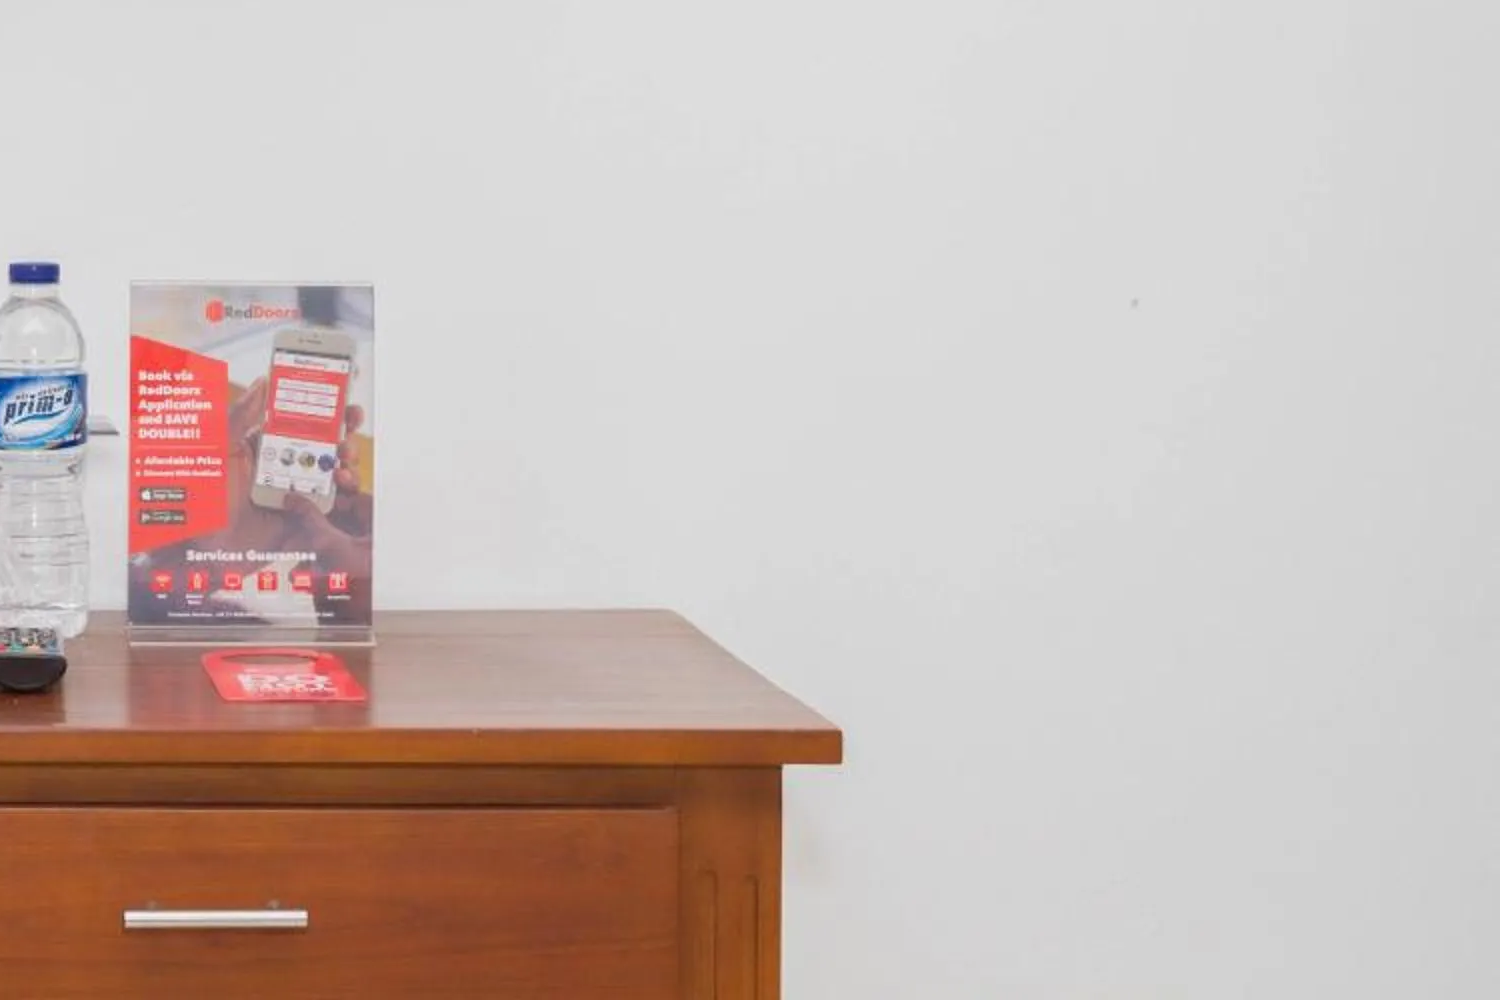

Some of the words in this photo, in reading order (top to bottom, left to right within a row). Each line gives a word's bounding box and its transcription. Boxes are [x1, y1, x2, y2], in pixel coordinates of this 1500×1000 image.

[138, 369, 171, 381] Book
[173, 369, 194, 381] via
[138, 398, 212, 412] Application
[138, 413, 162, 425] and
[164, 413, 198, 425] SAVE
[186, 549, 244, 561] Services
[245, 549, 318, 561] Guarantee
